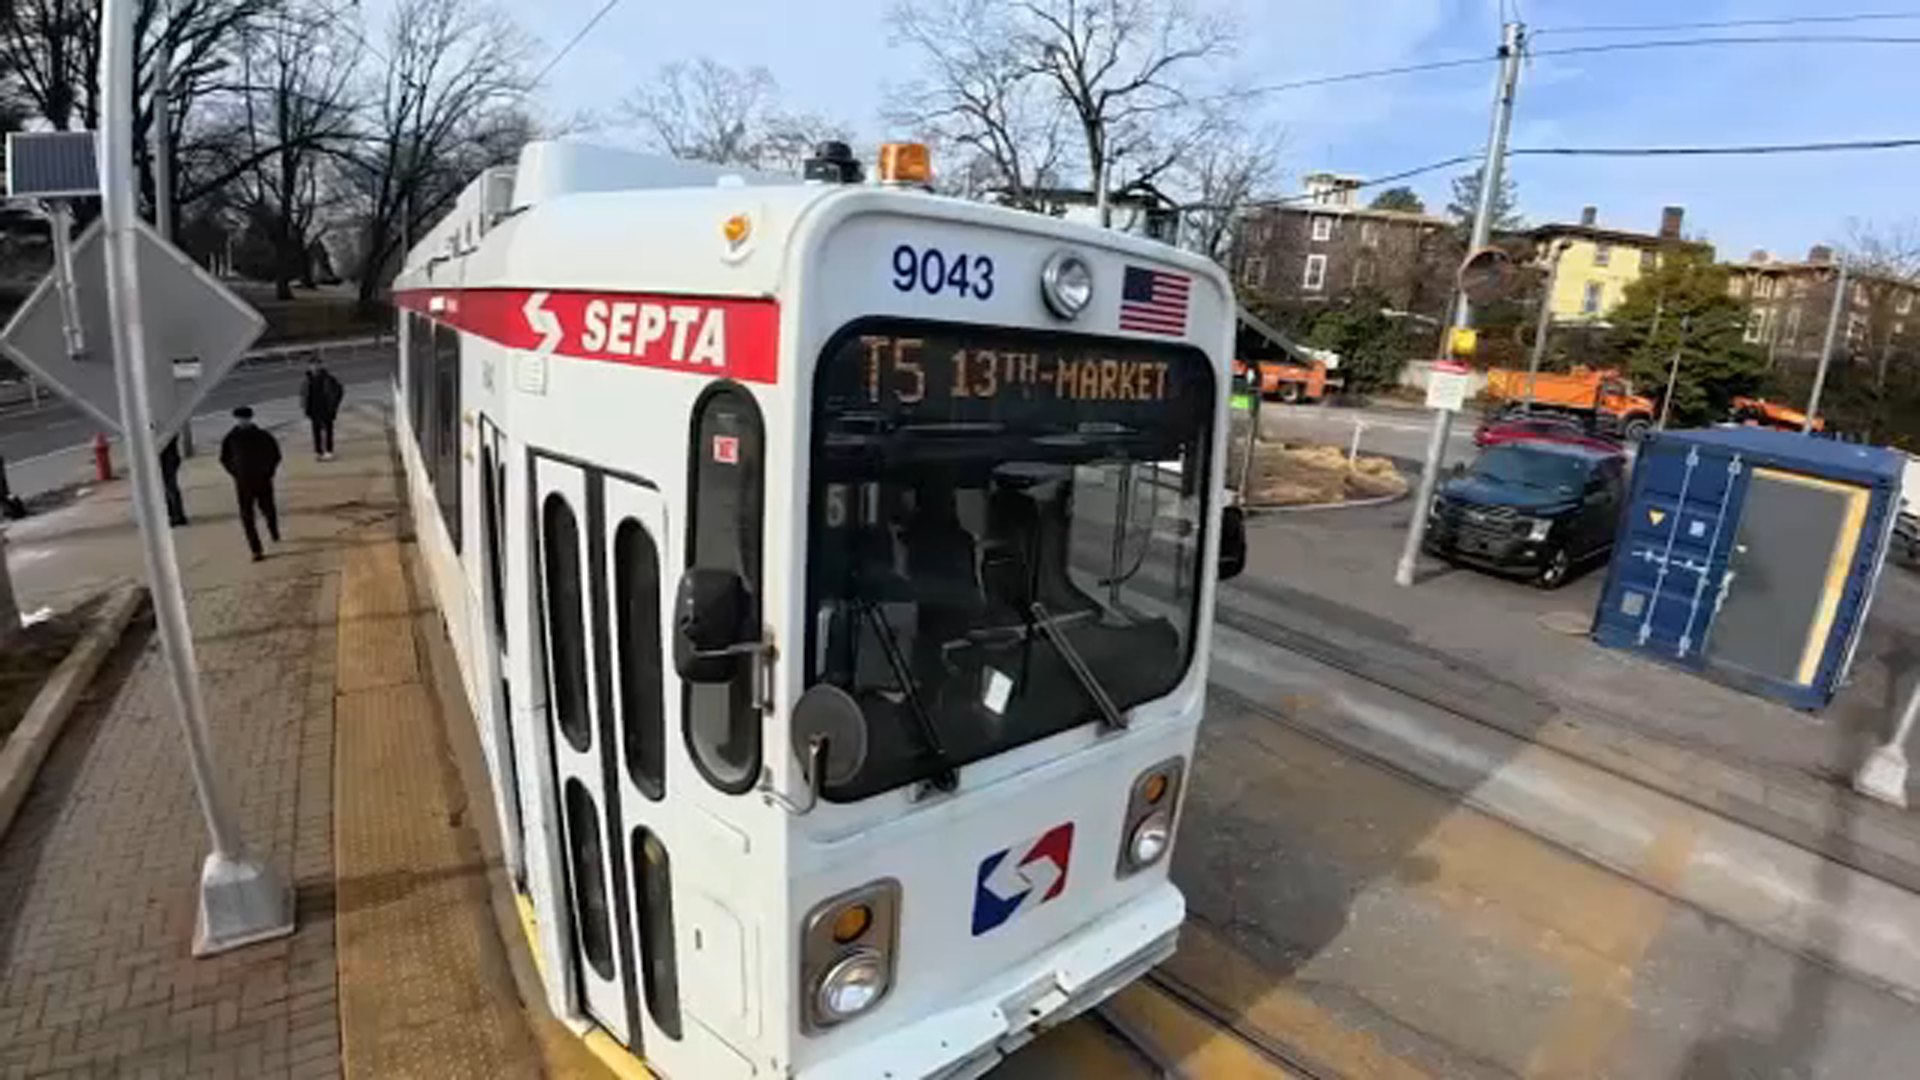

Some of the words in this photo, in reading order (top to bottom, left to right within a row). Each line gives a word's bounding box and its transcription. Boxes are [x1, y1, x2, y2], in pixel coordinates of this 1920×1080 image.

[893, 244, 994, 301] 9043
[581, 299, 726, 367] SEPTA
[861, 335, 925, 403] T5
